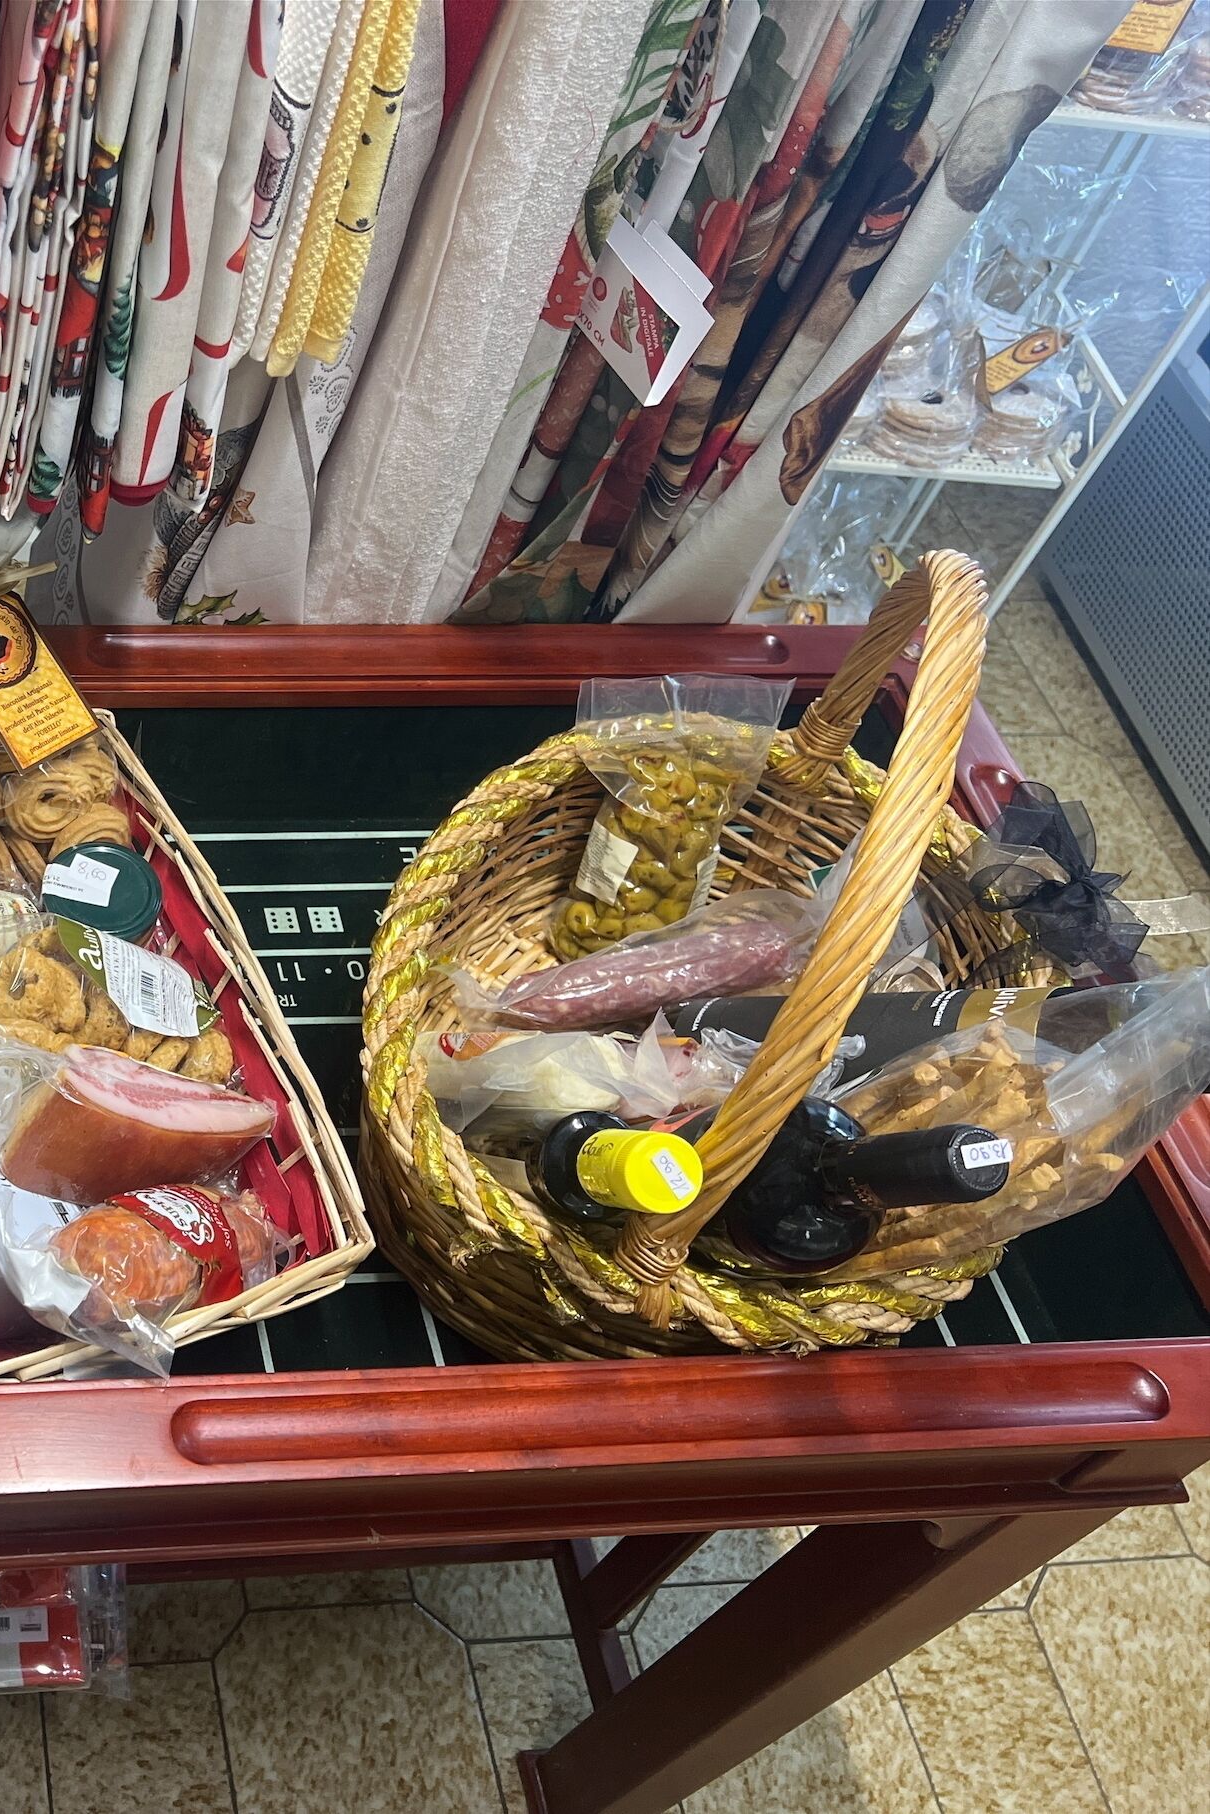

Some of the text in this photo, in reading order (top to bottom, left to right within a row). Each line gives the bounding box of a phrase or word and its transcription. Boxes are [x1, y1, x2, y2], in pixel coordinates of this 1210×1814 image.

[577, 311, 606, 348] X70 CM
[640, 306, 654, 358] IN DIGITALE
[647, 313, 660, 350] STAMPA
[1, 680, 54, 711] Biscottini Artigianali
[16, 694, 49, 714] di Montagna
[4, 692, 72, 734] prodotti nel Parco Naturale
[22, 708, 65, 734] dell'Alta Valsesia
[29, 723, 79, 755] produzione limitata
[78, 859, 108, 881] 8,60
[78, 926, 104, 972] auliv
[969, 1143, 1008, 1162] 13,90
[659, 1155, 690, 1191] 12,90
